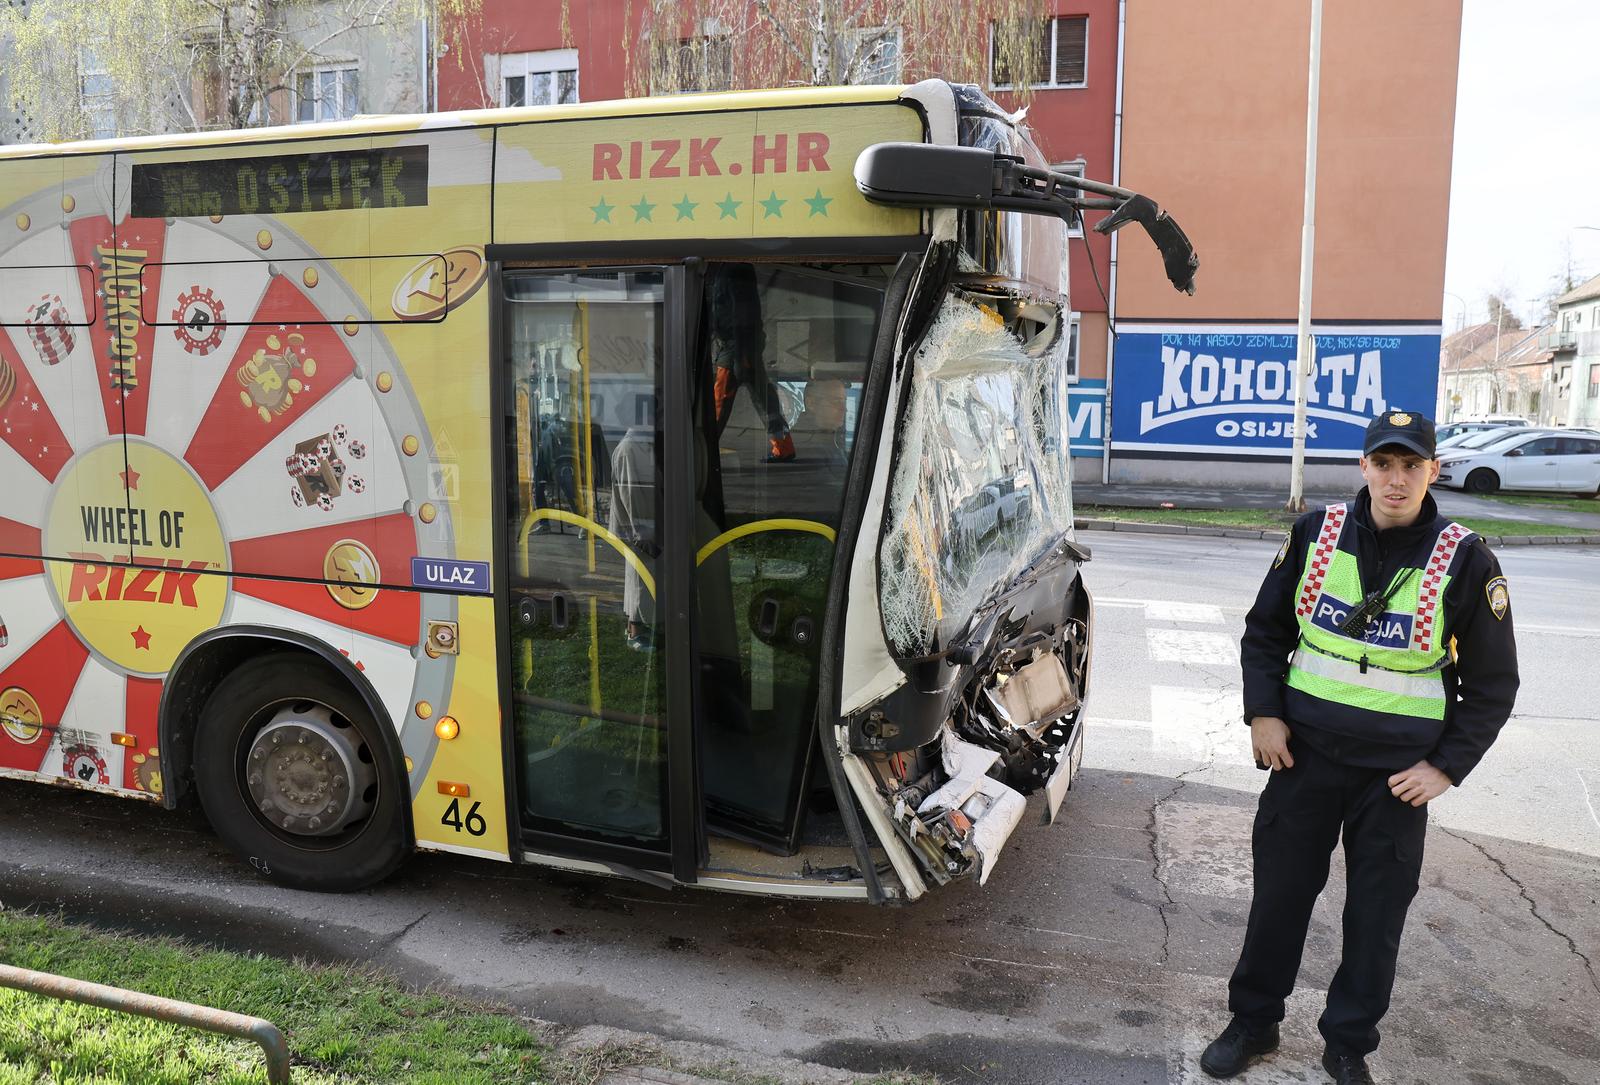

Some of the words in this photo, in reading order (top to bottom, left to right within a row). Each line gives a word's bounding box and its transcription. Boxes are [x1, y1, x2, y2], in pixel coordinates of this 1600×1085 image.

[592, 131, 832, 182] RIZK.HR
[236, 154, 406, 214] OSIJEK
[95, 244, 148, 388] JACKPOT!
[187, 307, 211, 333] R
[1188, 333, 1202, 347] NA
[1158, 345, 1387, 418] KOHORTA
[1215, 420, 1319, 440] OSIJEK
[81, 505, 153, 547] WHEEL
[159, 510, 185, 549] OF
[66, 551, 209, 608] RIZK
[426, 564, 476, 585] ULAZ
[441, 797, 487, 837] 46
